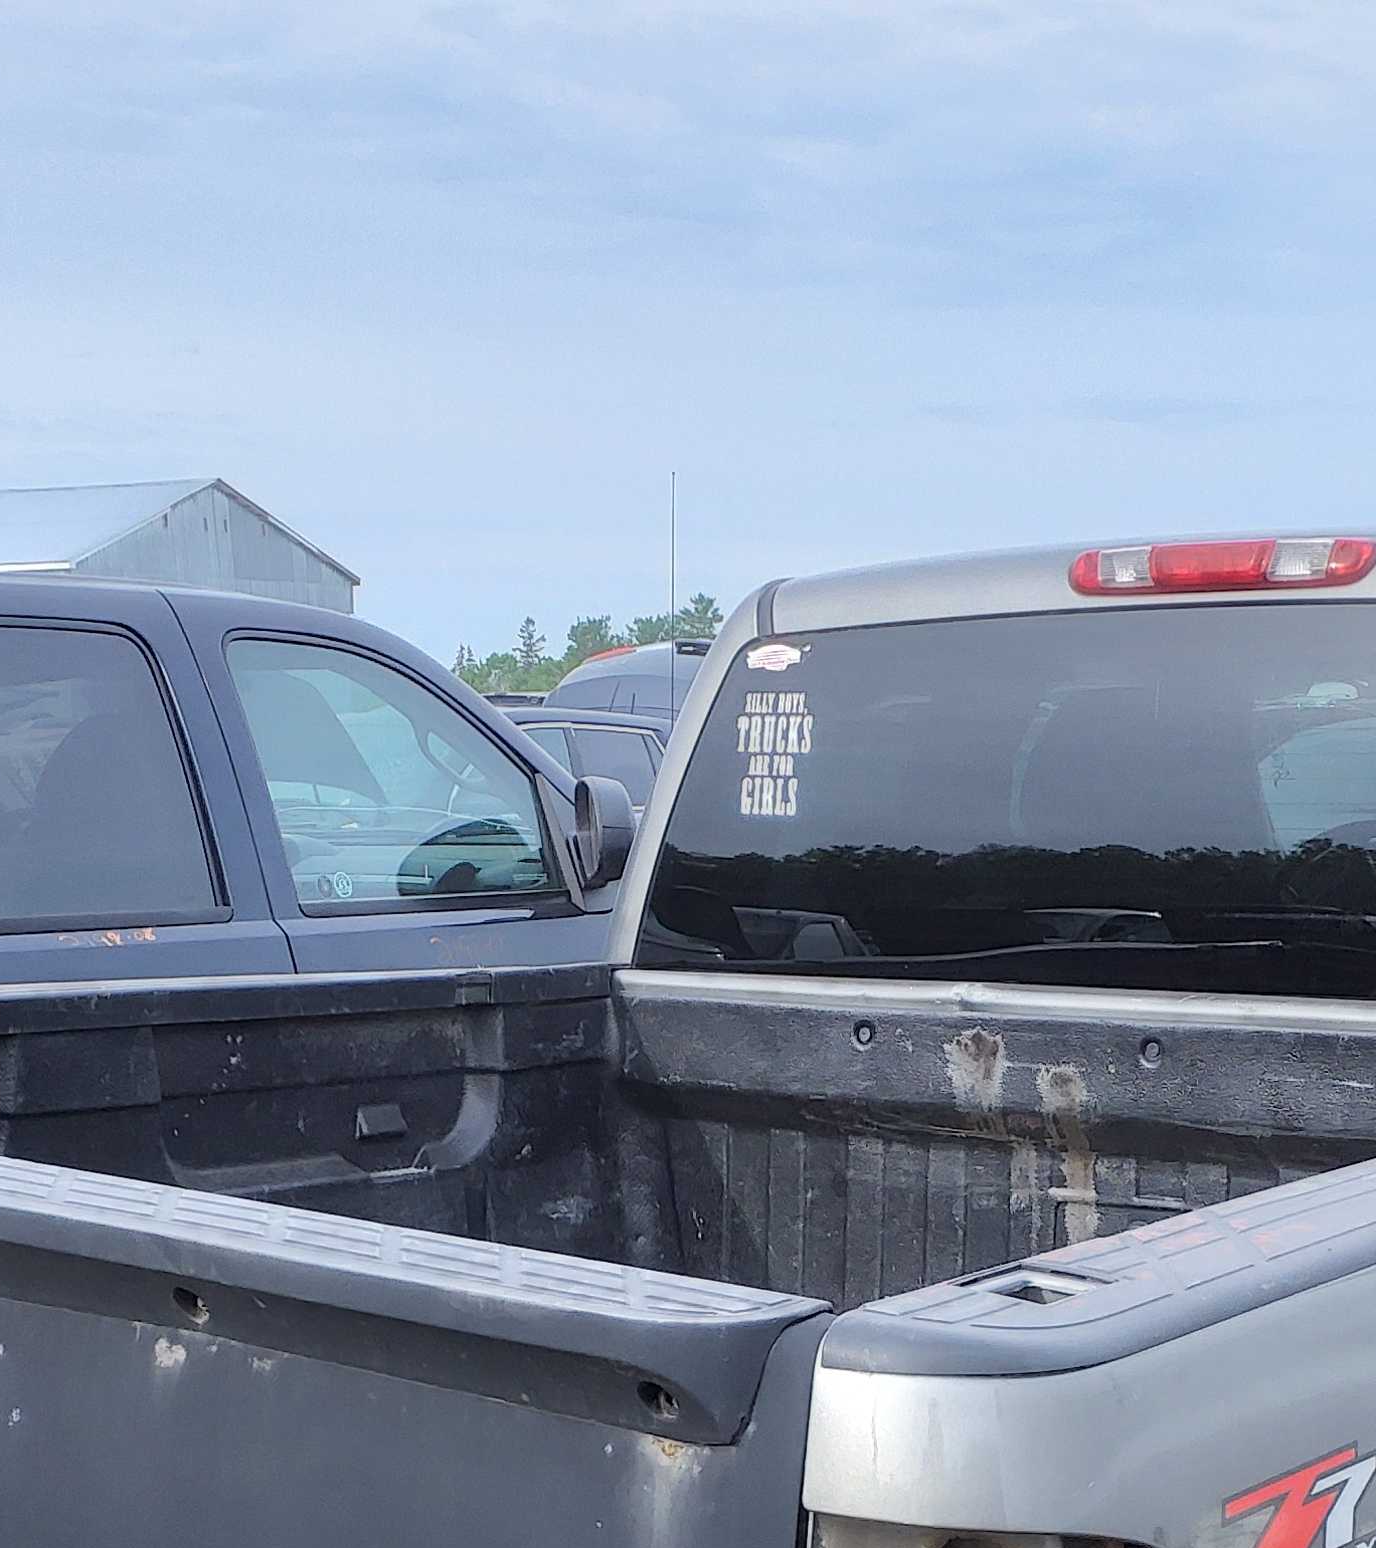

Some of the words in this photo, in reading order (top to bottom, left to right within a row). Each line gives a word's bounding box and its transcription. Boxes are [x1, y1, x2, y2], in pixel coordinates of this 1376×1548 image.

[744, 692, 775, 713] SILLY
[736, 715, 814, 753] TRUCKS
[748, 755, 770, 776] ARE
[772, 755, 794, 776] FOR
[740, 778, 798, 816] GIRLS
